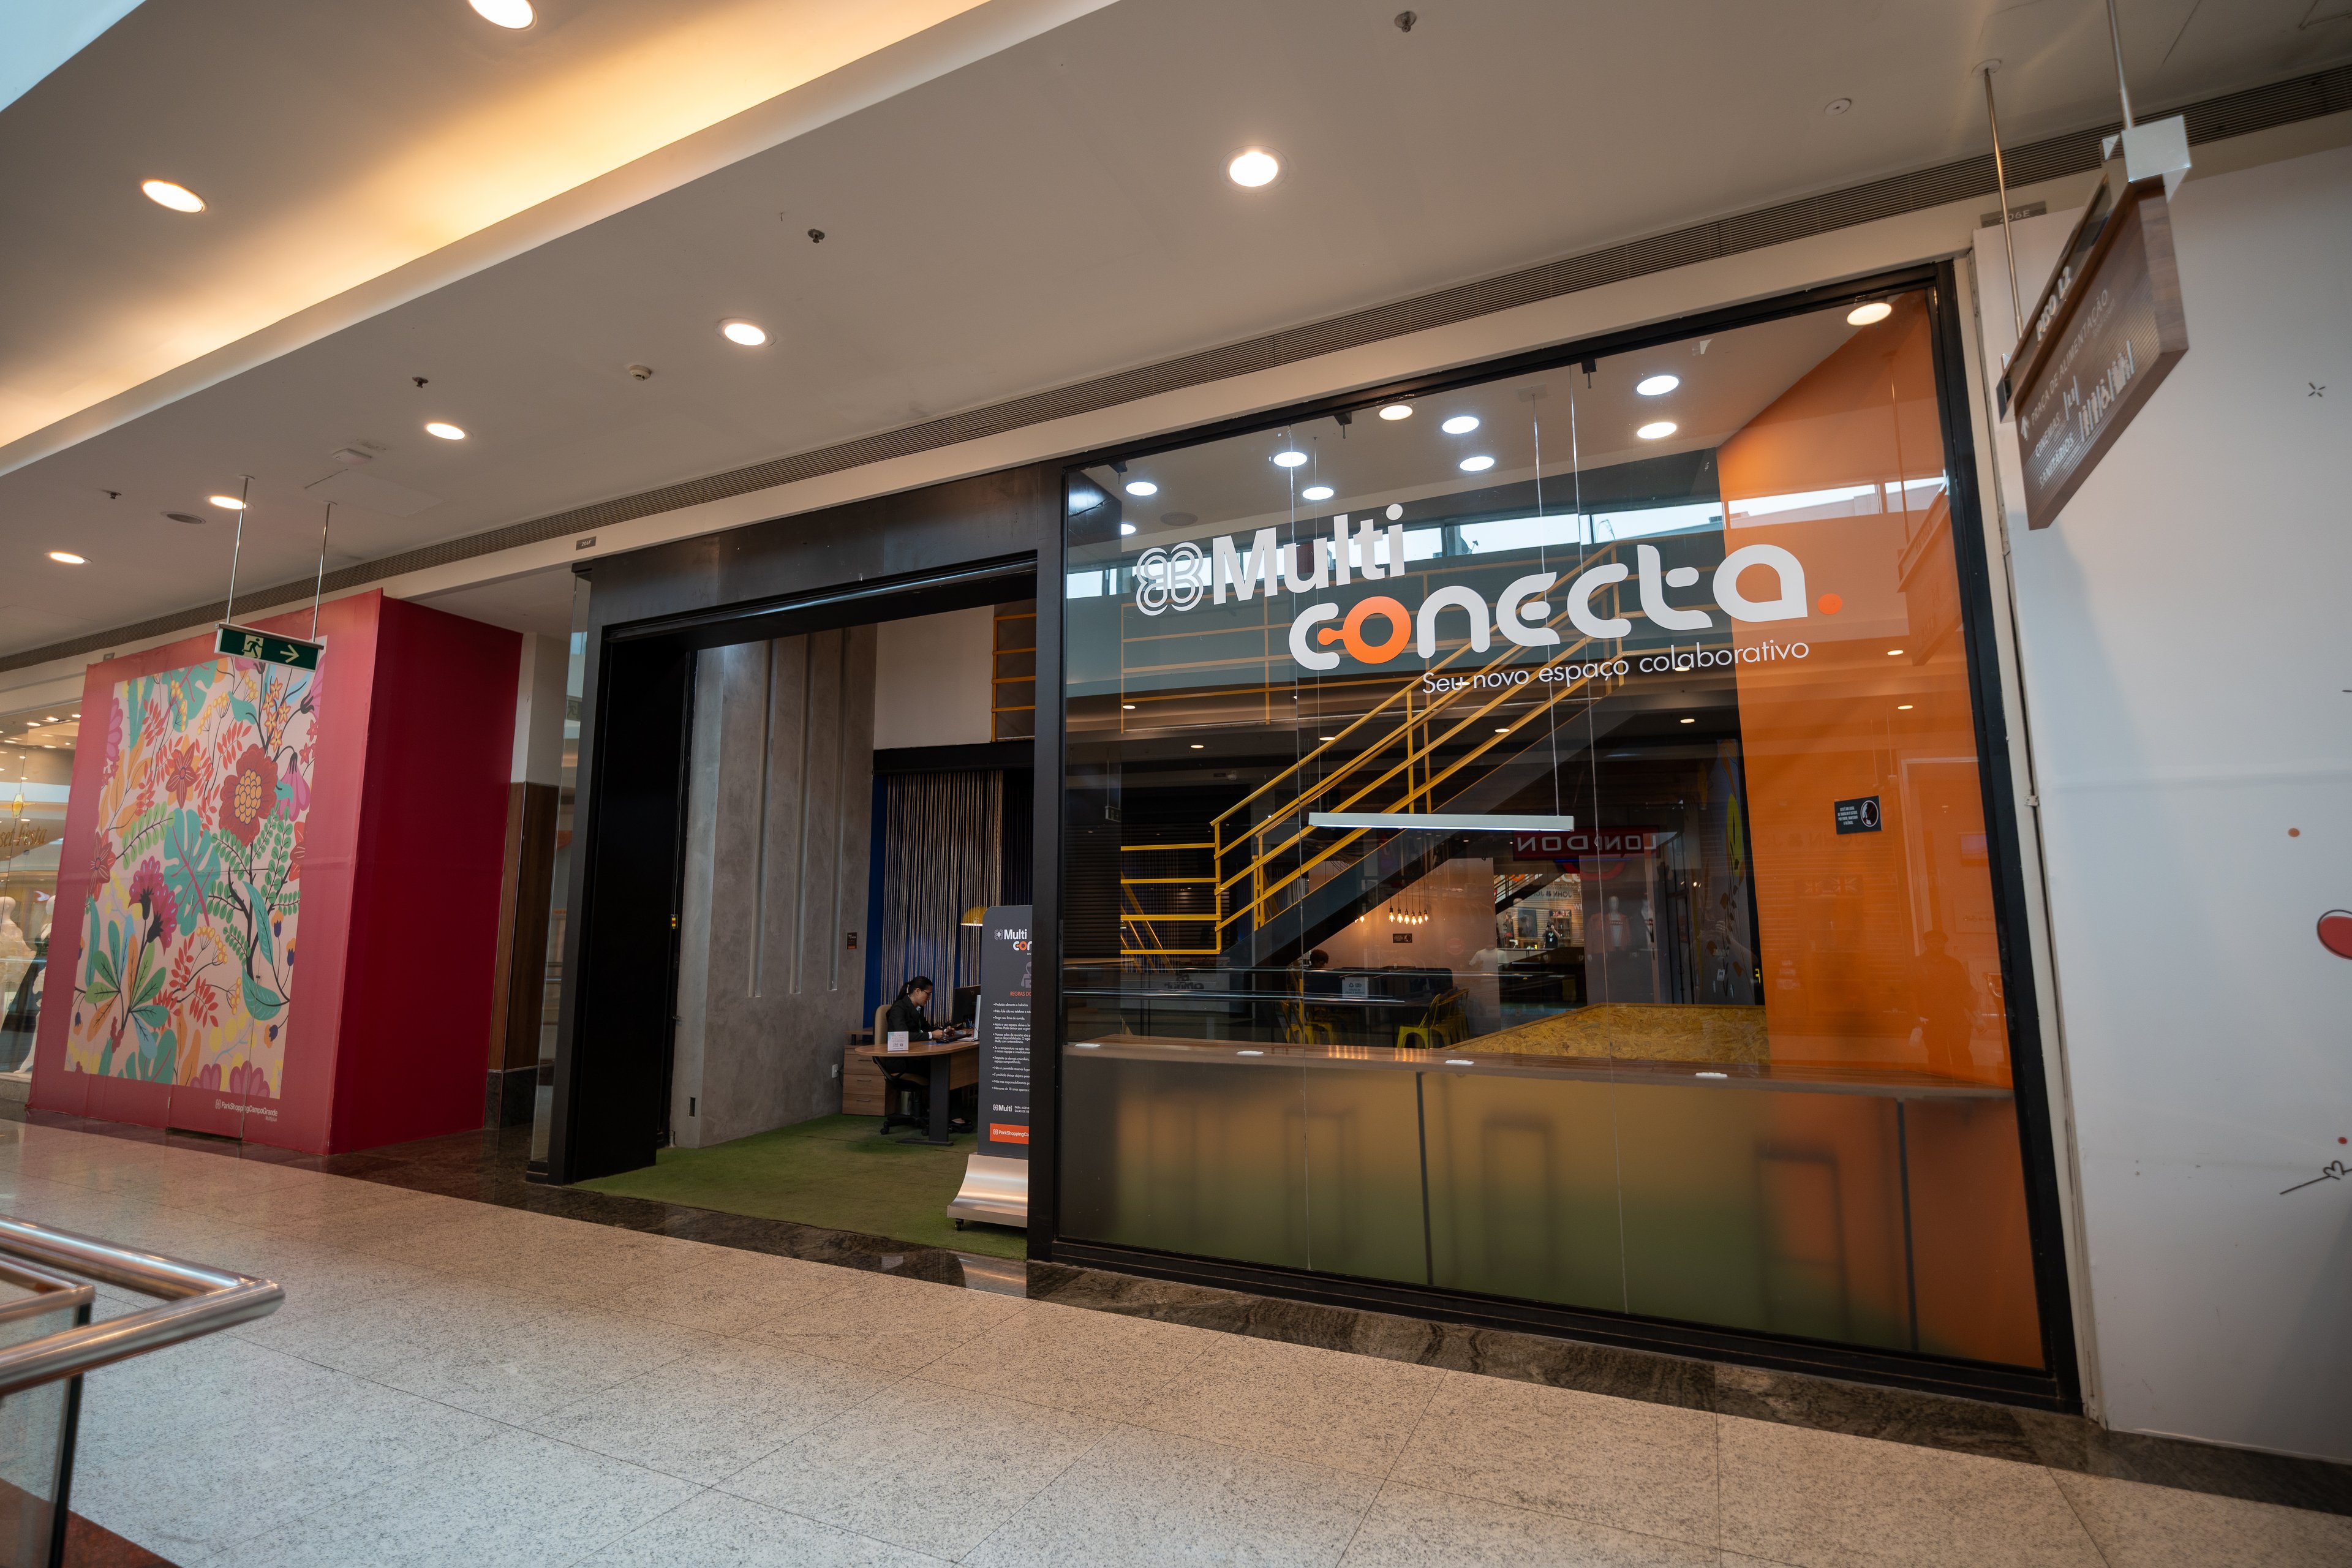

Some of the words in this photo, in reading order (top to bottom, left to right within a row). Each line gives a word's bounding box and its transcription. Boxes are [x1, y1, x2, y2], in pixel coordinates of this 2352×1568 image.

[2036, 295, 2056, 341] PISO
[2031, 390, 2049, 426] PRAÇA
[2049, 373, 2059, 394] DE
[2059, 289, 2108, 380] ALIMENTAÇÃO
[1212, 502, 1405, 605] Multi
[1422, 672, 1463, 693] Seu
[1473, 670, 1529, 688] novo
[1538, 660, 1629, 687] espaço
[1639, 646, 1809, 679] colaborativo
[1004, 929, 1027, 940] Multi
